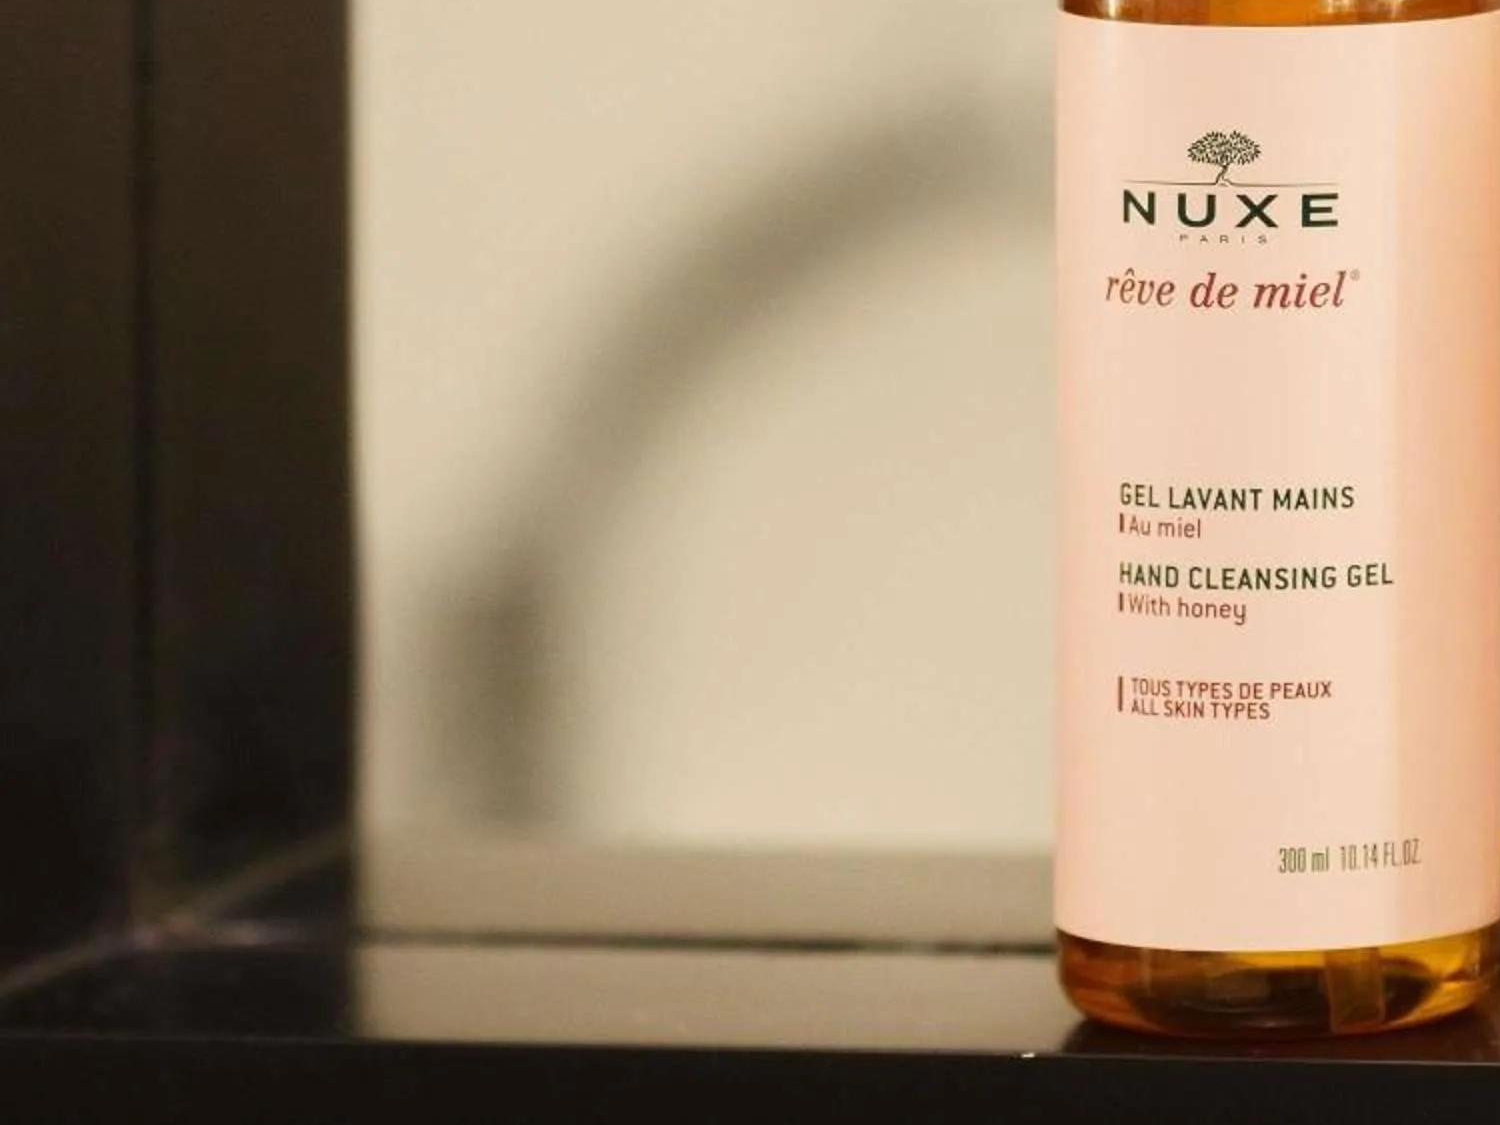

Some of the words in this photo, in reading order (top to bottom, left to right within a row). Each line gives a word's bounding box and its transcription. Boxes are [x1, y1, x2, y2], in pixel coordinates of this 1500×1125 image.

[1122, 189, 1339, 228] NUXE
[1179, 234, 1268, 244] PARIS
[1105, 268, 1175, 307] rêve
[1190, 273, 1239, 309] de
[1120, 482, 1160, 508] GEL
[1168, 487, 1262, 511] LAVANT
[1273, 486, 1355, 511] MAINS
[1129, 515, 1151, 537] Au
[1158, 517, 1201, 539] miel
[1120, 562, 1179, 588] HAND
[1189, 566, 1338, 590] CLEANSING
[1346, 563, 1393, 587] GEL
[1128, 594, 1171, 617] With
[1177, 596, 1246, 626] honey
[1131, 677, 1171, 697] TOUS
[1176, 680, 1233, 699] TYPES
[1240, 682, 1264, 700] DE
[1270, 680, 1332, 699] PEAUX
[1131, 699, 1159, 716] ALL
[1164, 701, 1205, 718] SKIN
[1210, 702, 1270, 719] TYPES
[1279, 848, 1306, 873] 300
[1311, 846, 1329, 872] ml
